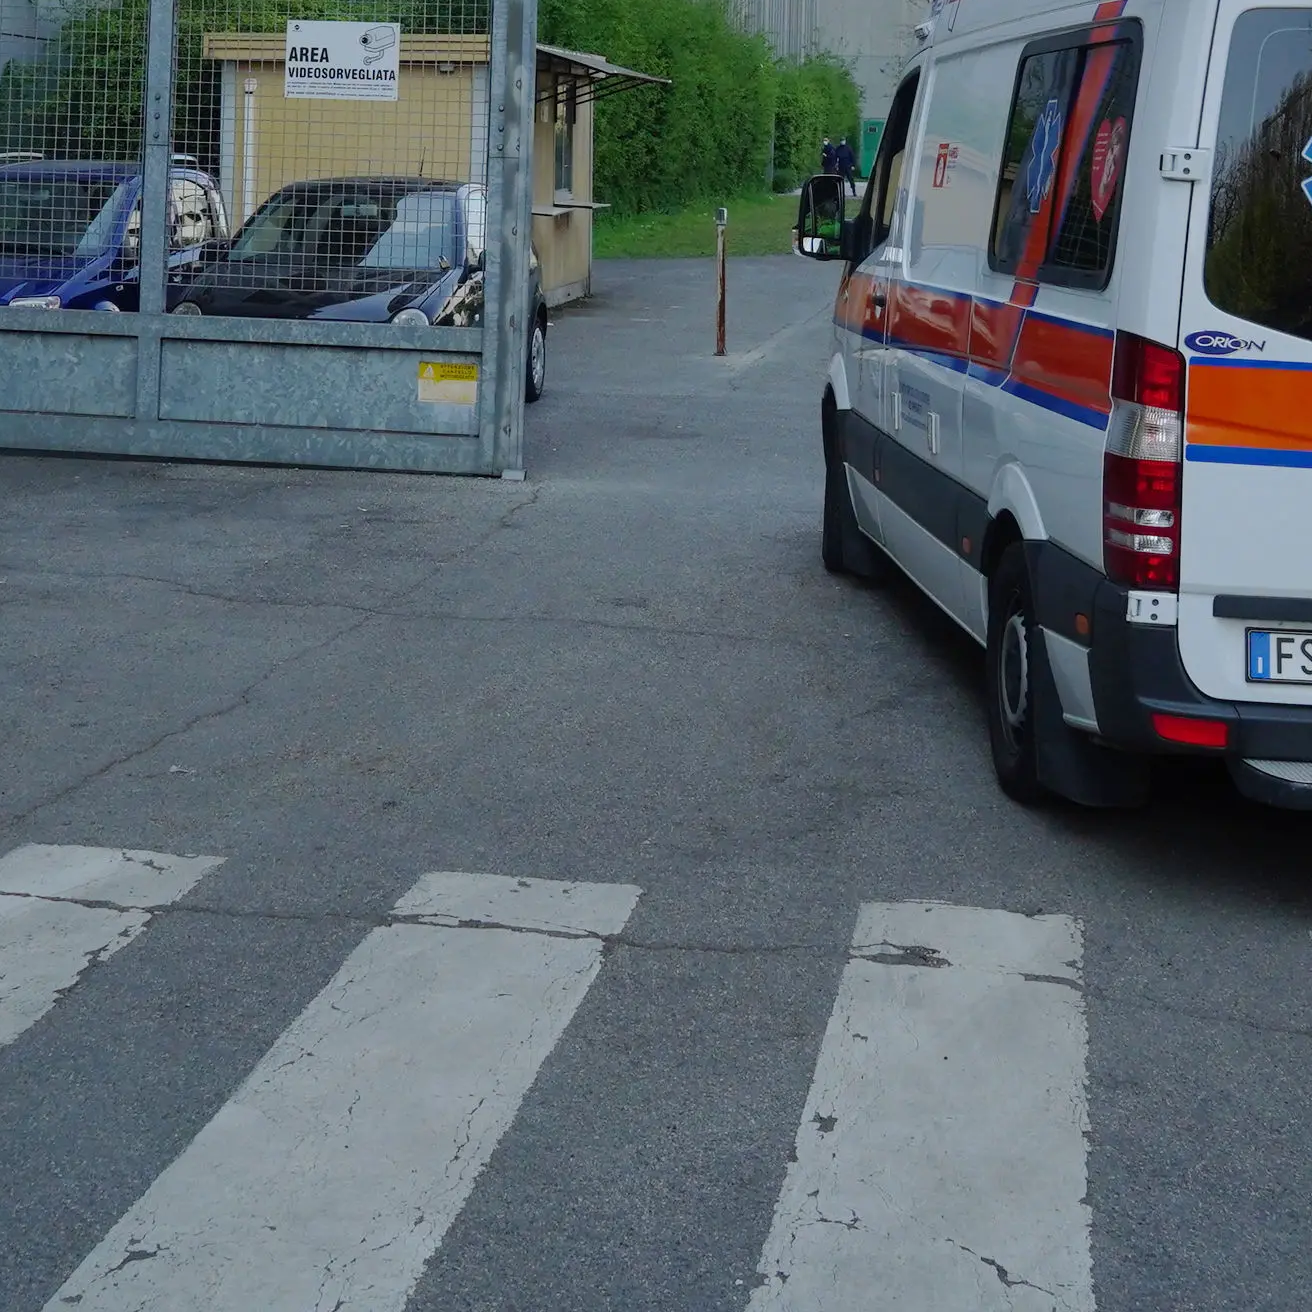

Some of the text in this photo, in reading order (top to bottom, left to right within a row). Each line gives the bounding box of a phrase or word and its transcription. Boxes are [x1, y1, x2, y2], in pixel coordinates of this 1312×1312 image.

[288, 46, 330, 63] AREA
[288, 66, 396, 81] VIDEOSORVEGLIATA
[1195, 335, 1267, 352] ORION
